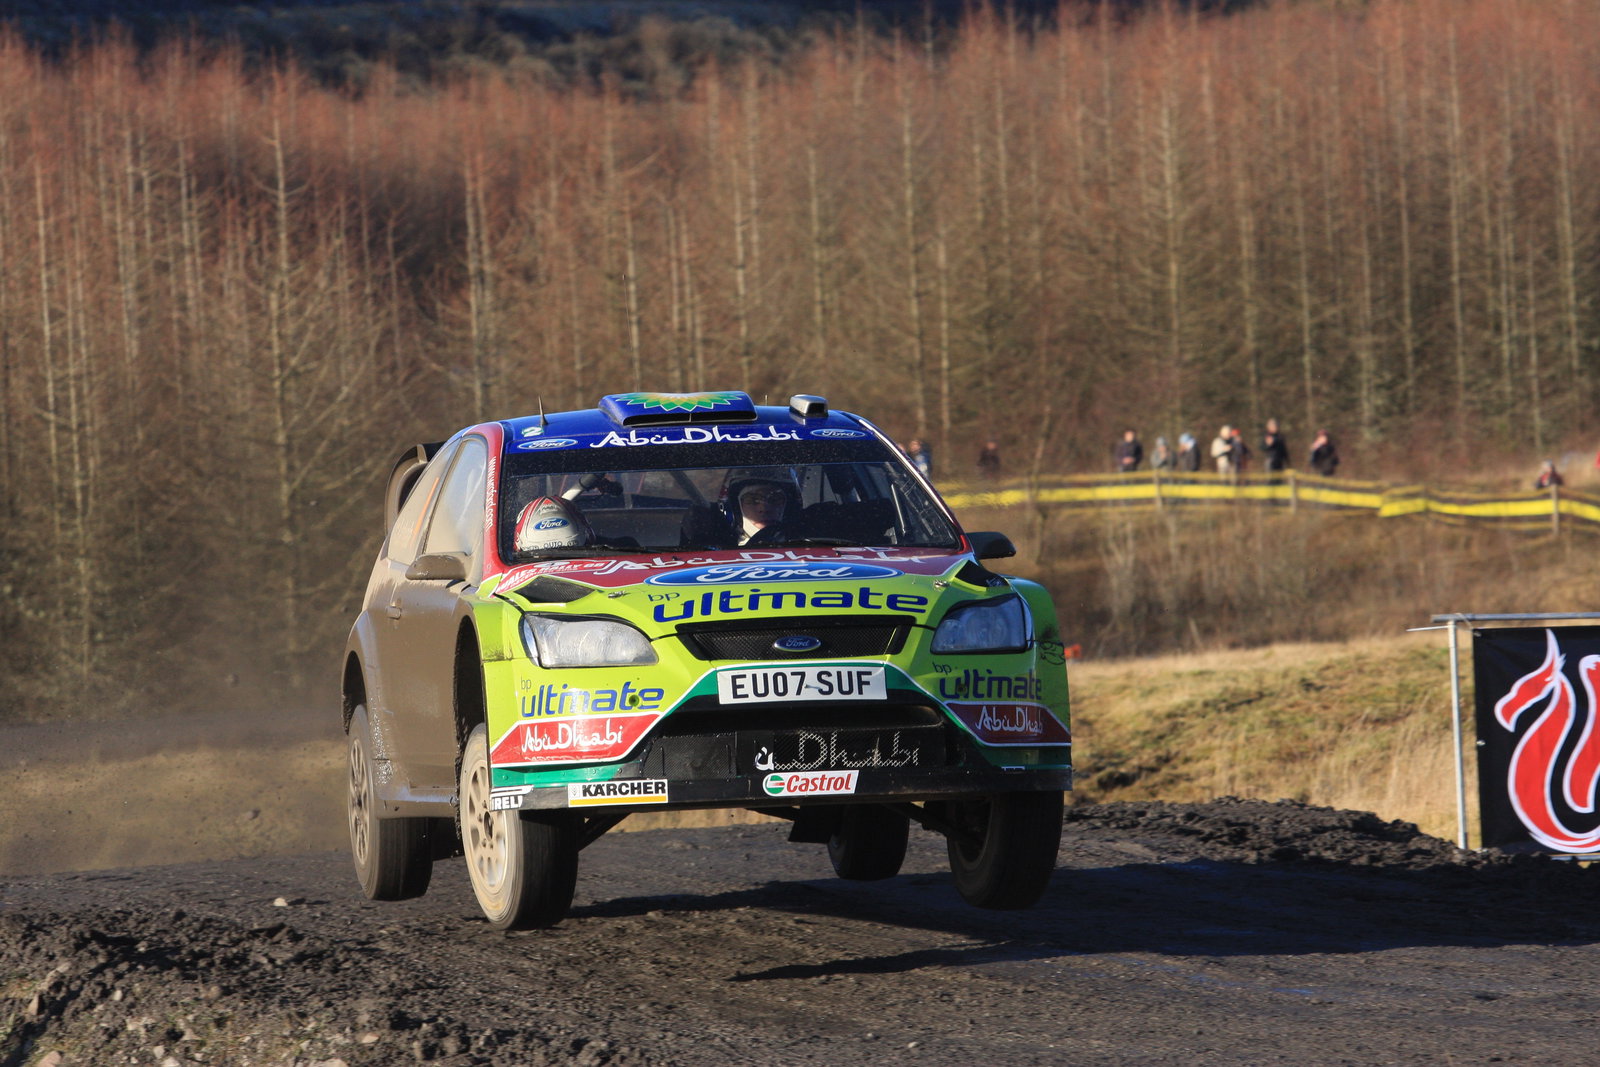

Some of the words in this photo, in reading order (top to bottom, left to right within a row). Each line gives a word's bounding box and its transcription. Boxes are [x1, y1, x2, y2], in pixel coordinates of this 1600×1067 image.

[821, 428, 856, 438] Ford
[529, 440, 567, 449] Ford
[539, 518, 563, 530] Ford
[696, 562, 853, 582] Ford
[648, 592, 681, 602] bp
[653, 587, 929, 623] ultimate
[785, 637, 810, 648] Ford
[932, 661, 952, 676] bp
[520, 676, 532, 693] bp
[730, 671, 806, 699] EU07
[816, 670, 873, 696] SUF
[939, 668, 1043, 701] ultimate
[521, 681, 664, 718] ultimate
[581, 781, 666, 798] KÄRCHER
[786, 773, 852, 793] Castrol
